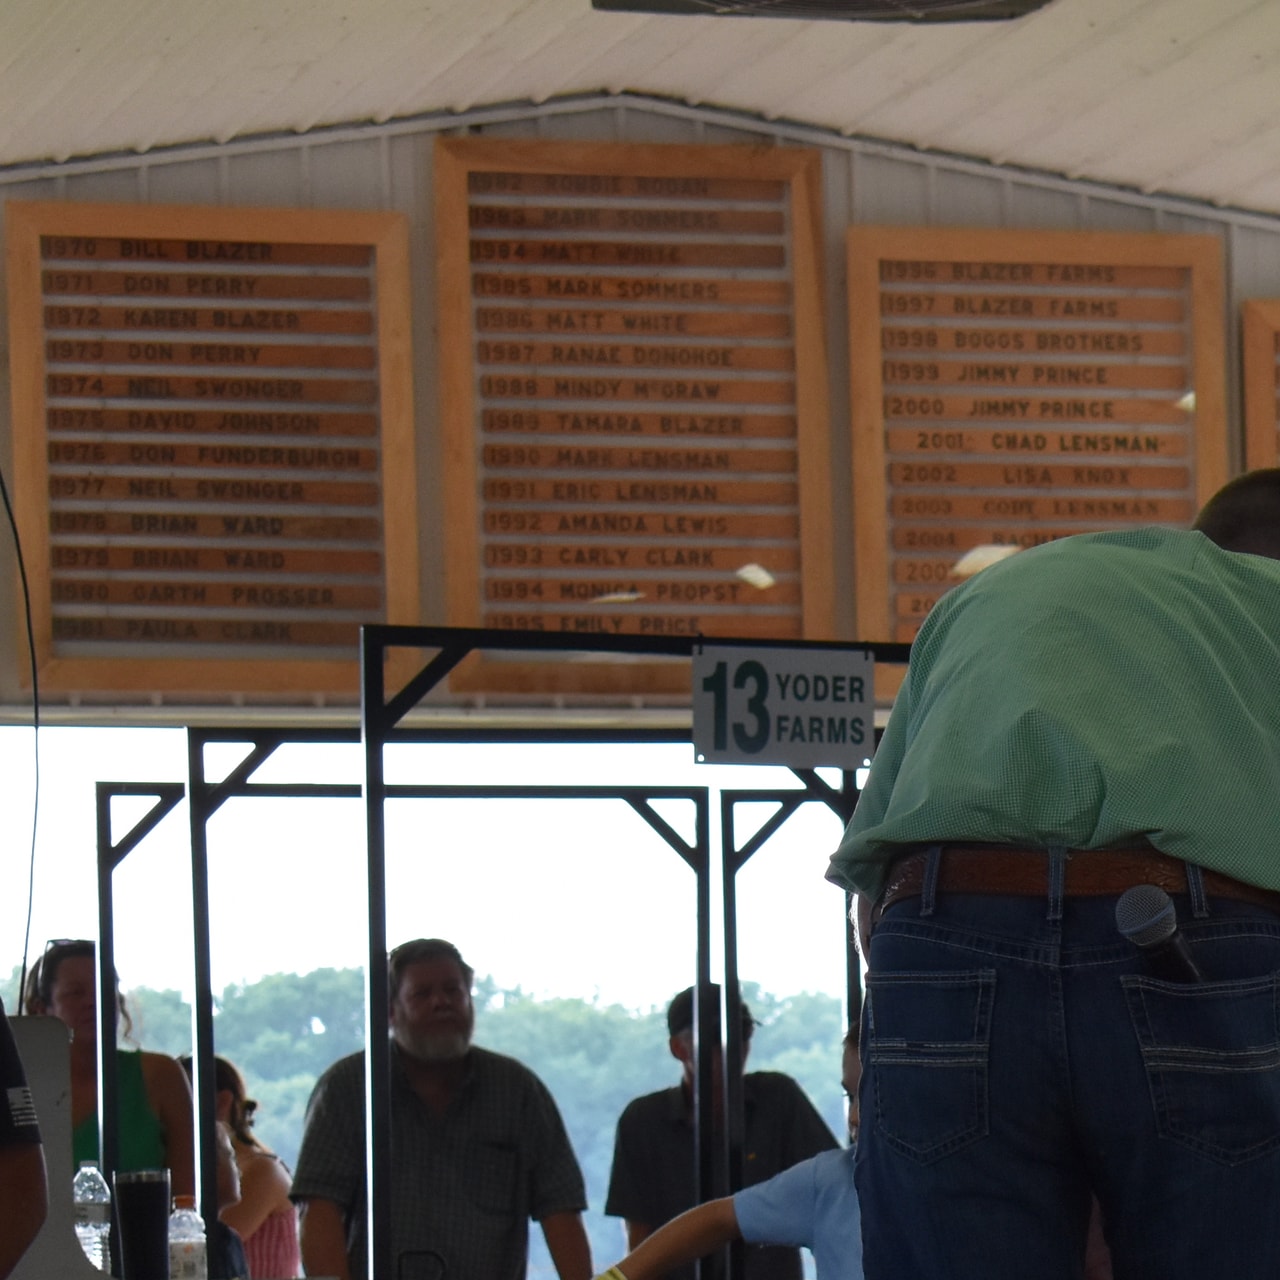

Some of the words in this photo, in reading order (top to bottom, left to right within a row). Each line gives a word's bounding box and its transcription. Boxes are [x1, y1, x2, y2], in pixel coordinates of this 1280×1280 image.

[46, 239, 97, 257] 1970
[120, 240, 169, 258] BILL
[186, 241, 272, 259] BLAZER
[542, 244, 598, 261] MATT
[888, 263, 936, 279] 1996
[952, 264, 1032, 280] BLAZER
[1047, 266, 1115, 282] FARMS
[47, 274, 93, 290] 1971
[124, 276, 169, 293] DON
[187, 277, 257, 294] PERRY
[476, 276, 531, 294] 1985
[547, 279, 603, 296] MARK
[618, 281, 719, 299] SOMMERS
[888, 296, 935, 312] 1997
[953, 297, 1033, 314] BLAZER
[1050, 300, 1119, 316] FARMS
[47, 308, 102, 326] 1972
[124, 310, 197, 327] KAREN
[213, 311, 299, 328] BLAZER
[480, 310, 534, 329] 1986
[547, 312, 603, 329] MATT
[622, 314, 688, 331] WHITE
[889, 330, 938, 347] 1998
[1036, 334, 1143, 351] BROTHERS
[51, 342, 104, 360] 1973
[128, 343, 173, 360] DON
[191, 345, 261, 362] PERRY
[482, 345, 535, 362] 1987
[552, 346, 621, 363] RANAE
[634, 348, 734, 366] DONOHOE
[892, 364, 939, 380] 1999
[957, 366, 1020, 382] JIMMY
[1033, 367, 1107, 384] PRINCE
[51, 376, 104, 394] 1974
[128, 378, 177, 396] NEIL
[484, 377, 538, 395] 1988
[555, 379, 622, 396] MINDY
[892, 399, 944, 415] 2000
[970, 400, 1030, 416] JIMMY
[1040, 400, 1114, 418] PRINCE
[52, 411, 104, 428] 1975
[128, 412, 197, 429] DAVID
[218, 413, 320, 431] JOHNSON
[488, 413, 539, 430] 1989
[556, 415, 642, 431] TAMARA
[660, 416, 743, 433] BLAZER
[917, 432, 963, 449] 2001
[991, 433, 1047, 451] CHAD
[1060, 434, 1159, 452] LENSMAN
[131, 446, 175, 462] DON
[488, 448, 541, 465] 1990
[556, 450, 613, 467] MARK
[629, 451, 729, 468] LENSMAN
[902, 467, 956, 483] 2002
[1003, 468, 1053, 484] LISA
[1073, 468, 1129, 484] KNOX
[52, 479, 105, 495] 1977
[129, 480, 179, 497] NEIL
[488, 482, 536, 499] 1991
[553, 484, 600, 500] ERIC
[616, 484, 717, 501] LENSMAN
[903, 498, 953, 514] 2003
[1053, 501, 1159, 516] LENSMAN
[131, 516, 198, 532] BRIAN
[222, 517, 284, 535] WARD
[489, 513, 541, 530] 1992
[558, 515, 647, 531] AMANDA
[663, 517, 728, 533] LEWIS
[54, 548, 109, 566] 1979
[132, 550, 198, 567] BRIAN
[224, 551, 284, 568] WARD
[490, 548, 543, 565] 1993
[559, 549, 629, 564] CARLY
[645, 550, 714, 567] CLARK
[133, 585, 206, 601] GARTH
[232, 586, 333, 605] PROSSER
[492, 581, 543, 599] 1994
[657, 584, 740, 600] PROPST
[128, 621, 198, 637] PAULA
[221, 622, 292, 639] CLARK
[492, 617, 544, 632] 1995
[560, 617, 623, 632] EMILY
[640, 617, 699, 633] PRICE
[776, 674, 865, 703] YODER
[702, 660, 771, 754] 13
[776, 715, 865, 745] FARMS
